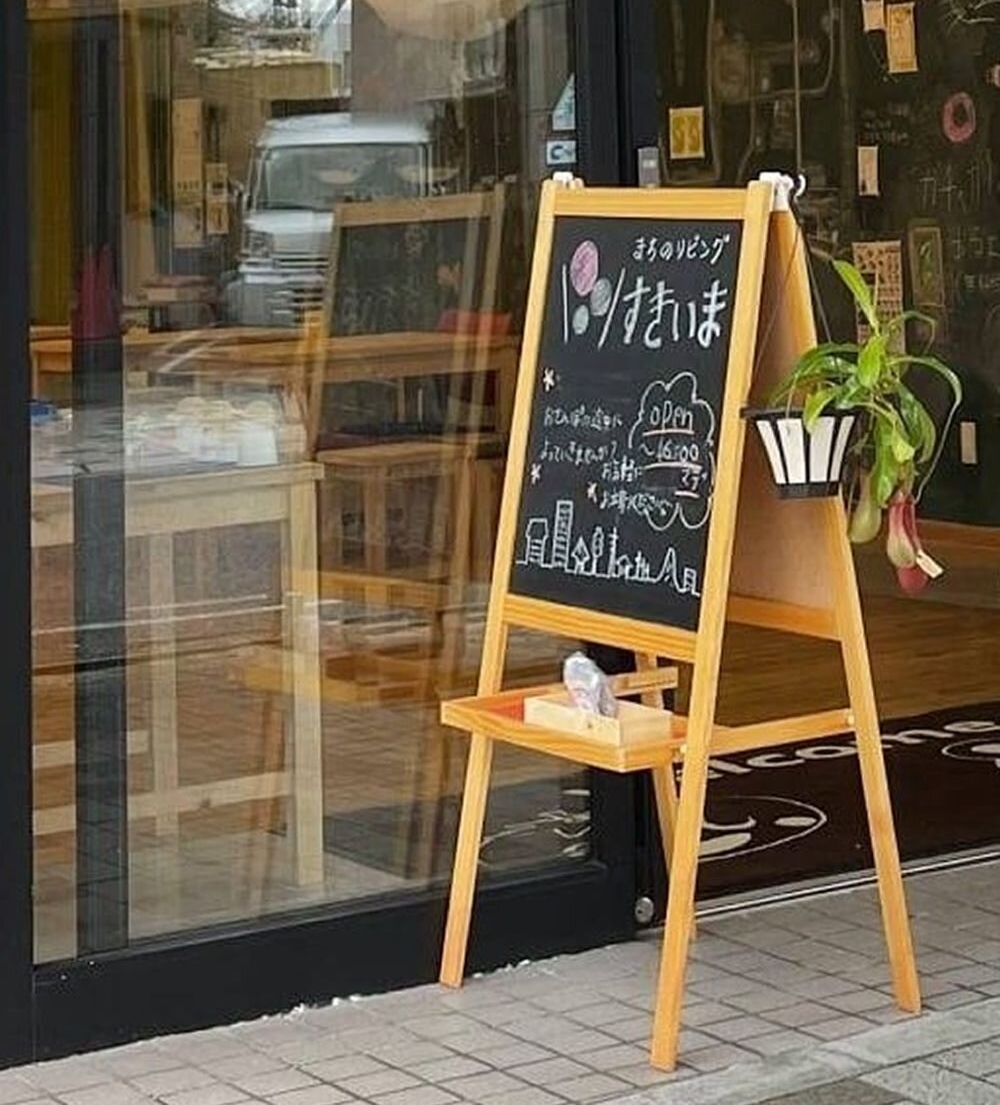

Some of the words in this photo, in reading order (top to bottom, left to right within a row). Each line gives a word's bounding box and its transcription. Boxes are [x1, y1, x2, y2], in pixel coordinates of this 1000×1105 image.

[632, 234, 730, 265] まちのリビング
[623, 276, 728, 348] すきいま
